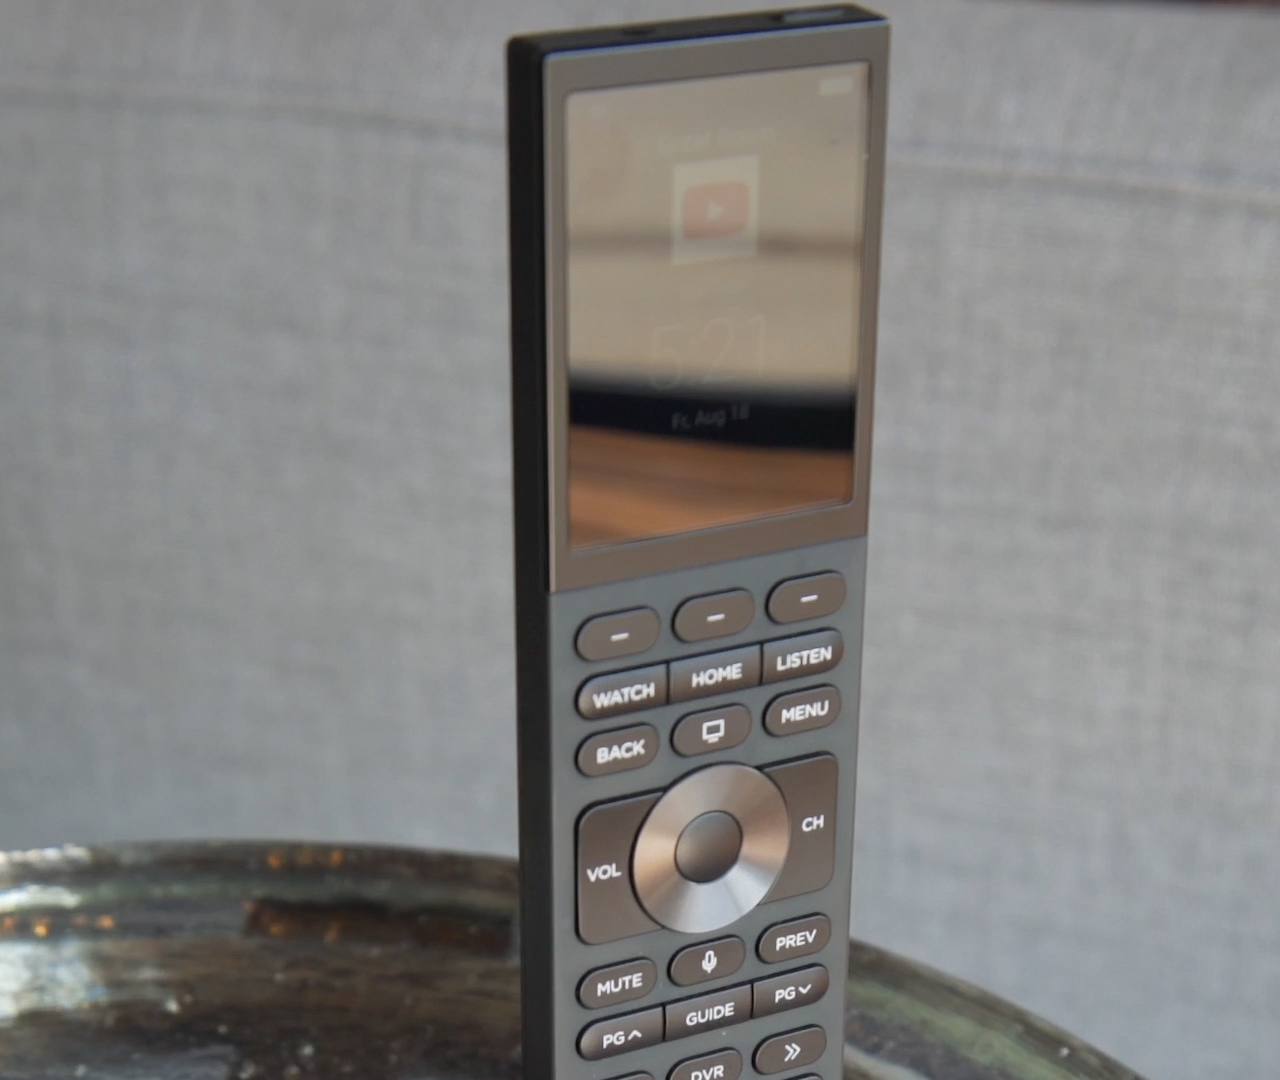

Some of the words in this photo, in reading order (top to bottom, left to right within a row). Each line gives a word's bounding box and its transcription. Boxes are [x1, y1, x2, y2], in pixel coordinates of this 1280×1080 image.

[694, 408, 726, 427] Aug
[776, 646, 832, 671] LISTEN
[691, 663, 743, 687] HOME
[592, 683, 655, 708] WATCH
[781, 700, 829, 724] MENU
[596, 739, 646, 764] BACK
[801, 815, 825, 832] CH
[586, 863, 622, 883] VOL
[775, 930, 817, 951] PREV
[596, 973, 643, 997] MUTE
[685, 1002, 735, 1026] GUIDE
